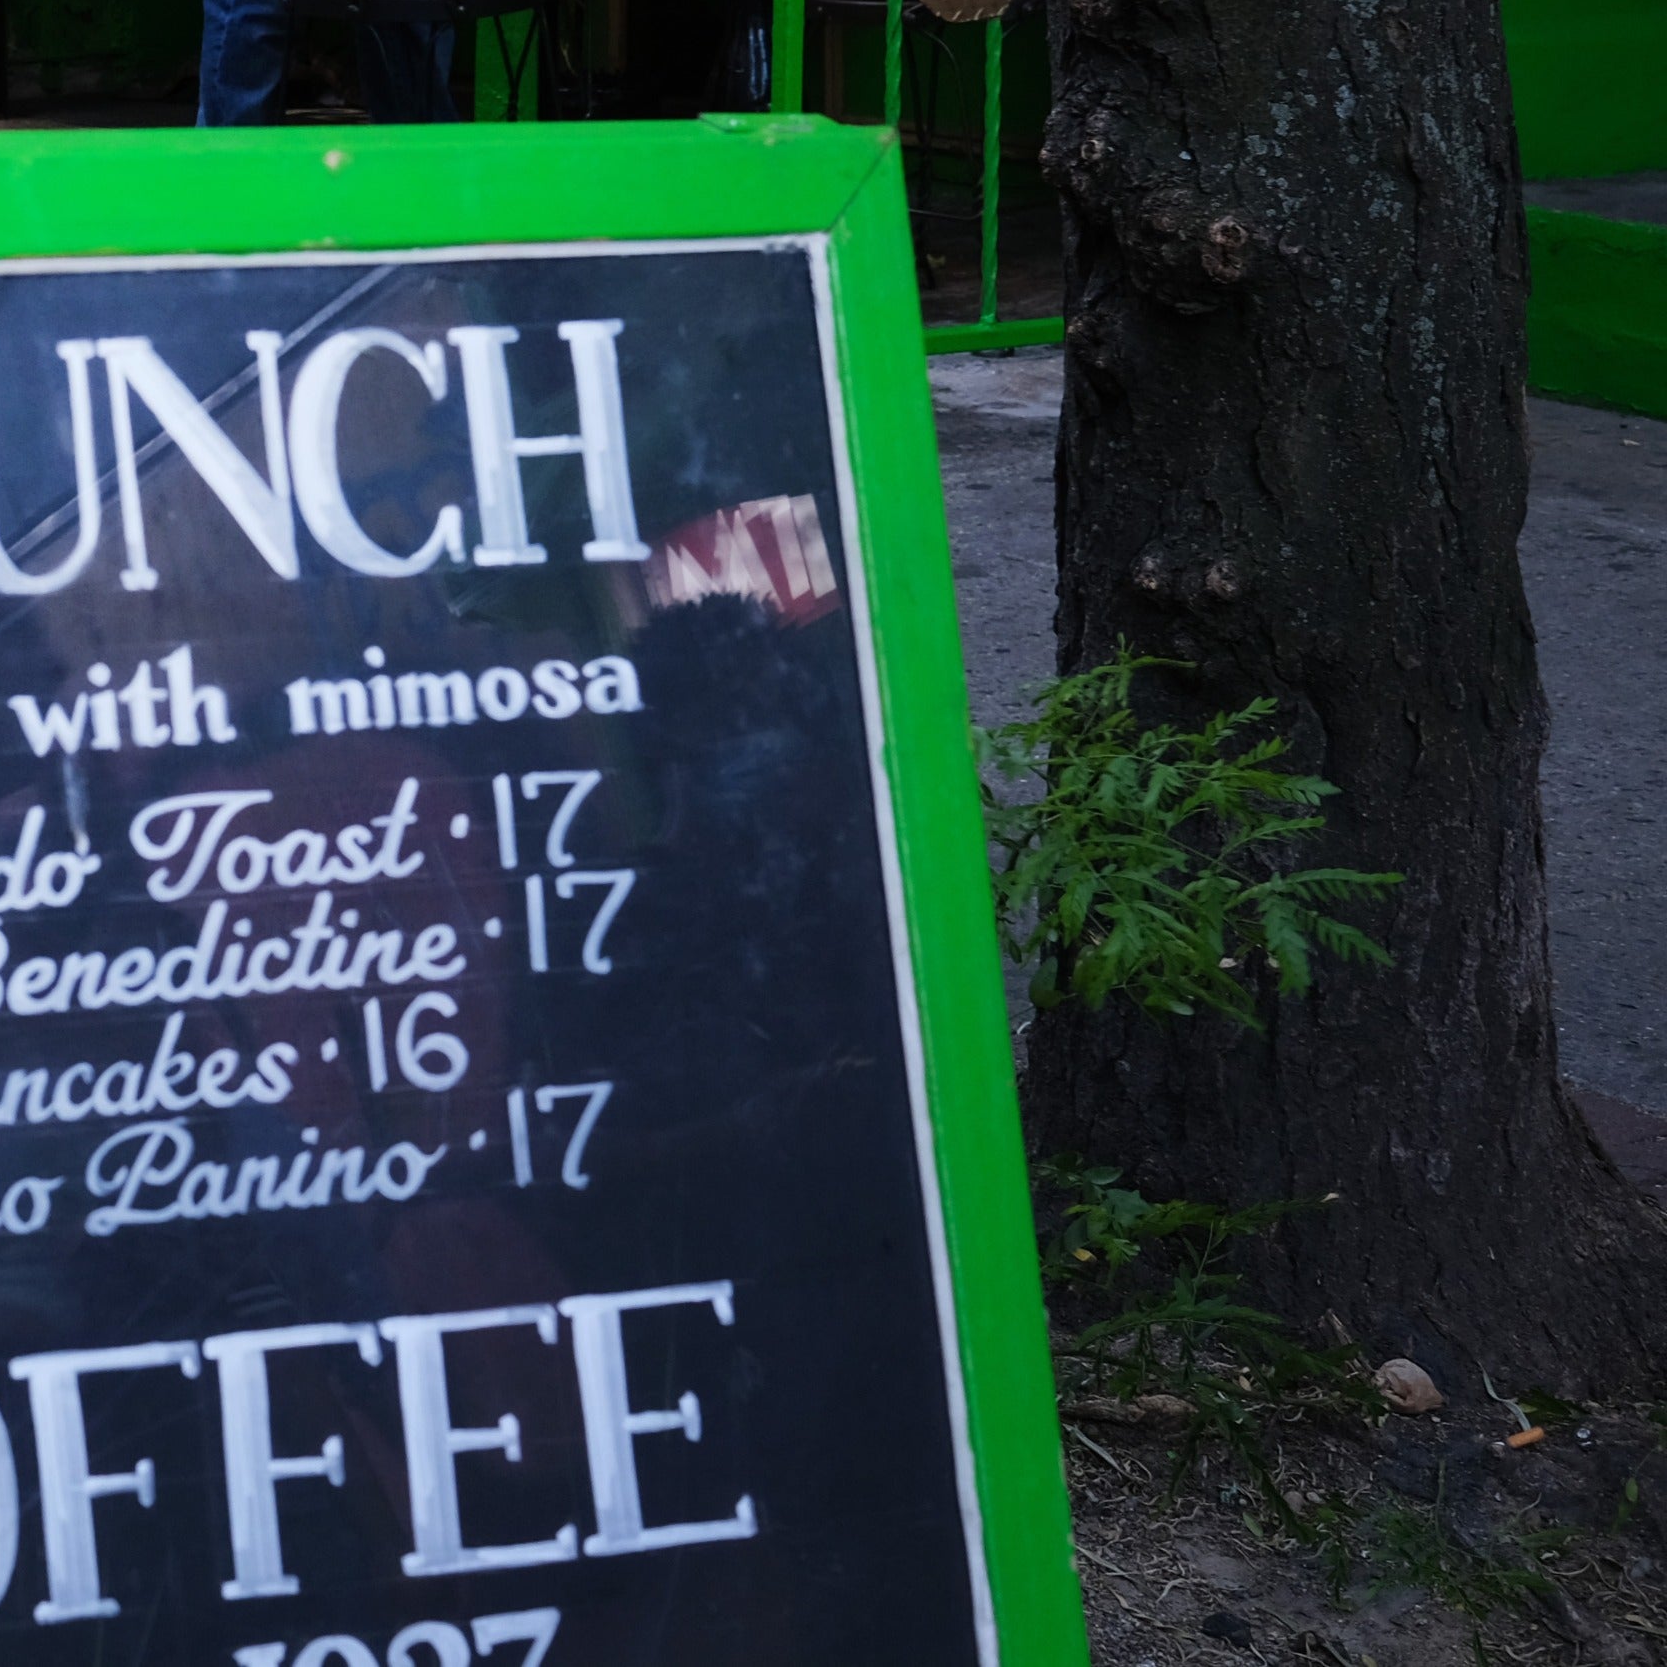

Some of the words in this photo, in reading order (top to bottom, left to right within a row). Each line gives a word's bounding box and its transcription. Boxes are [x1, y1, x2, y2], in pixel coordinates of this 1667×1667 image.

[5, 642, 239, 759] with
[283, 643, 646, 737] mimosa
[126, 775, 428, 904] Toast
[83, 1115, 450, 1238] Panino
